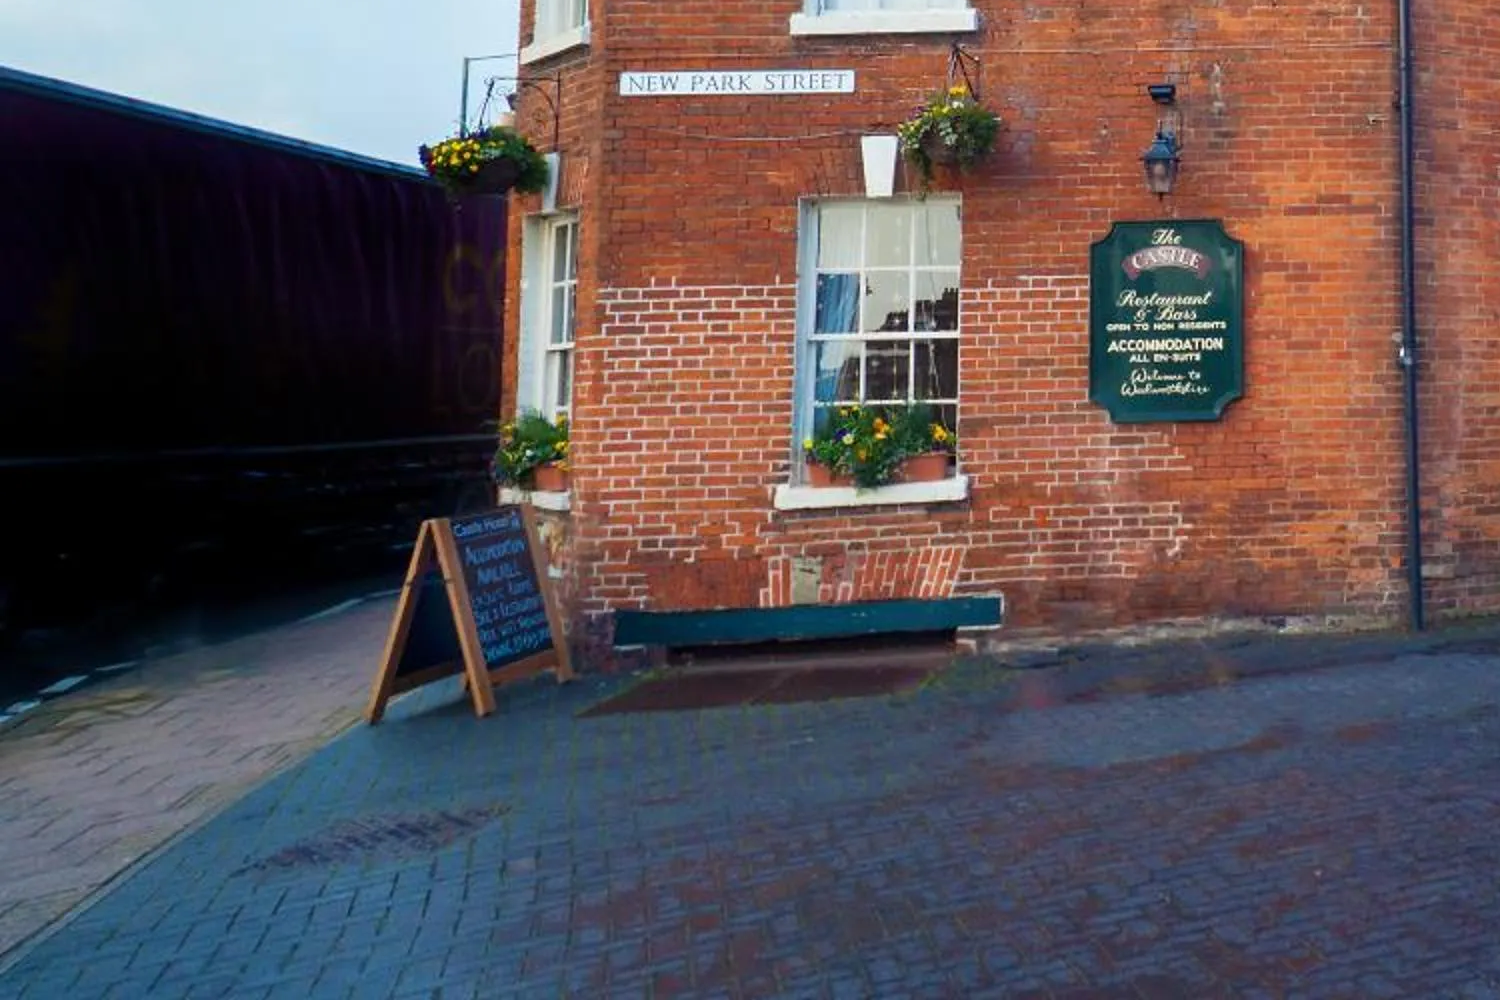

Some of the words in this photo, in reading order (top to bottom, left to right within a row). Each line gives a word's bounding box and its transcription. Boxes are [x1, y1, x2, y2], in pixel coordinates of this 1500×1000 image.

[628, 75, 679, 93] NEW
[691, 74, 752, 92] PARK
[764, 73, 848, 90] STREET
[1151, 228, 1181, 246] The
[1131, 247, 1202, 269] CASTLE
[1116, 289, 1213, 307] Restaurant
[1155, 306, 1197, 320] Bars
[1106, 323, 1131, 331] OPEN
[1135, 323, 1149, 331] TO
[1153, 322, 1175, 331] NON
[1178, 321, 1226, 330] RESIDENTS
[1107, 338, 1223, 352] ACCOMMODATION
[1129, 354, 1150, 363] ALL
[1188, 370, 1201, 380] to
